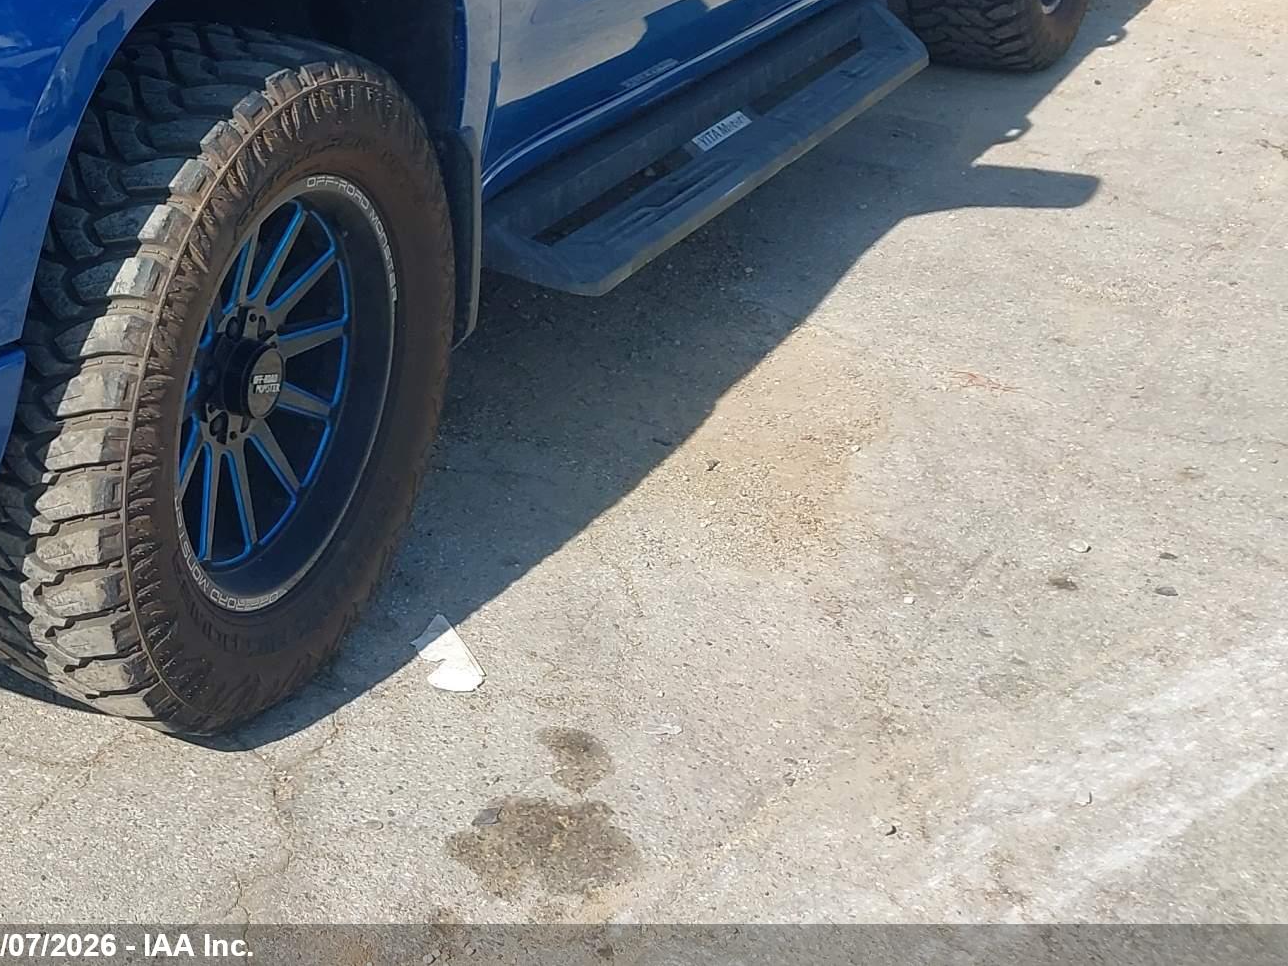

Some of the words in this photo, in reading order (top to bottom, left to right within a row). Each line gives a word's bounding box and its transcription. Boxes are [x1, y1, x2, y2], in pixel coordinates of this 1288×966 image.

[307, 176, 369, 210] OFF-ROAD
[368, 205, 398, 302] MONSTER
[253, 374, 278, 384] OFF-ROAD
